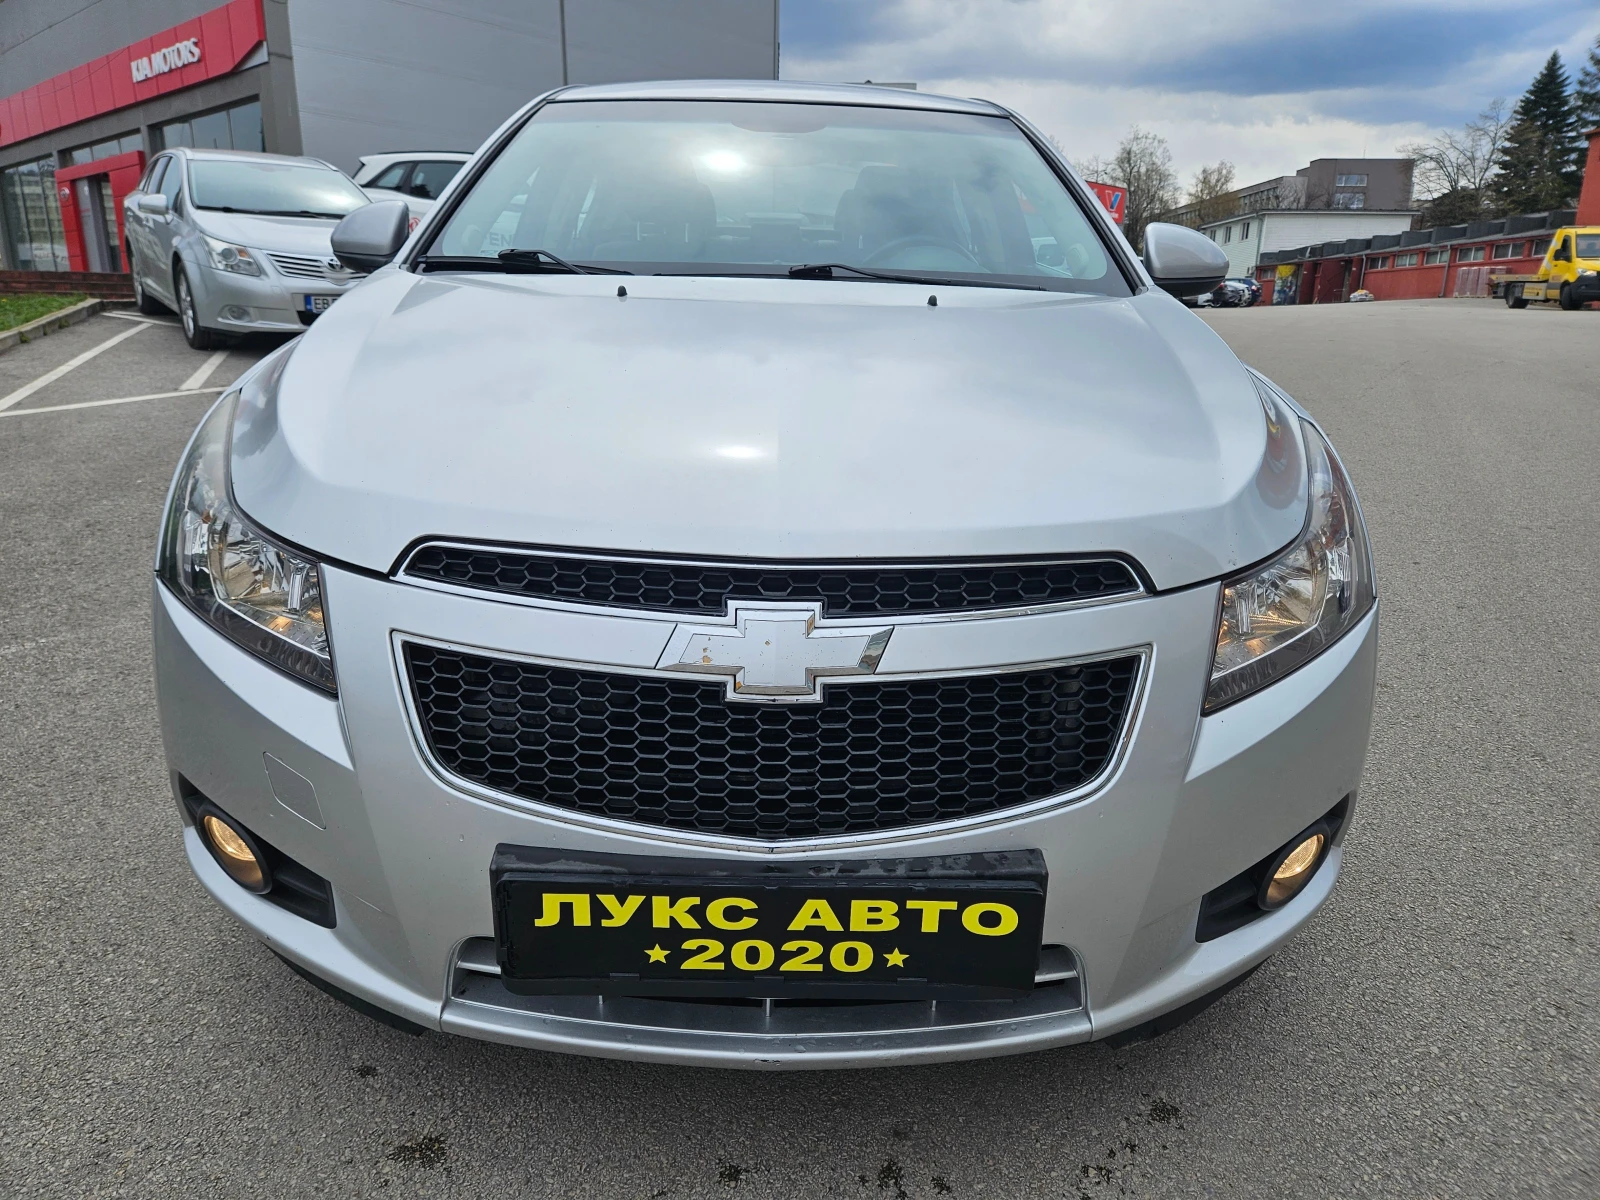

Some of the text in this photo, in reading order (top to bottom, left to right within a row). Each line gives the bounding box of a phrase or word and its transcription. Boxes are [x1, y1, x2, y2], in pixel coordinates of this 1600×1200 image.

[130, 37, 201, 83] KIA MOTORS
[534, 893, 1019, 936] ЛУКС АВТО
[680, 938, 874, 973] 2020
